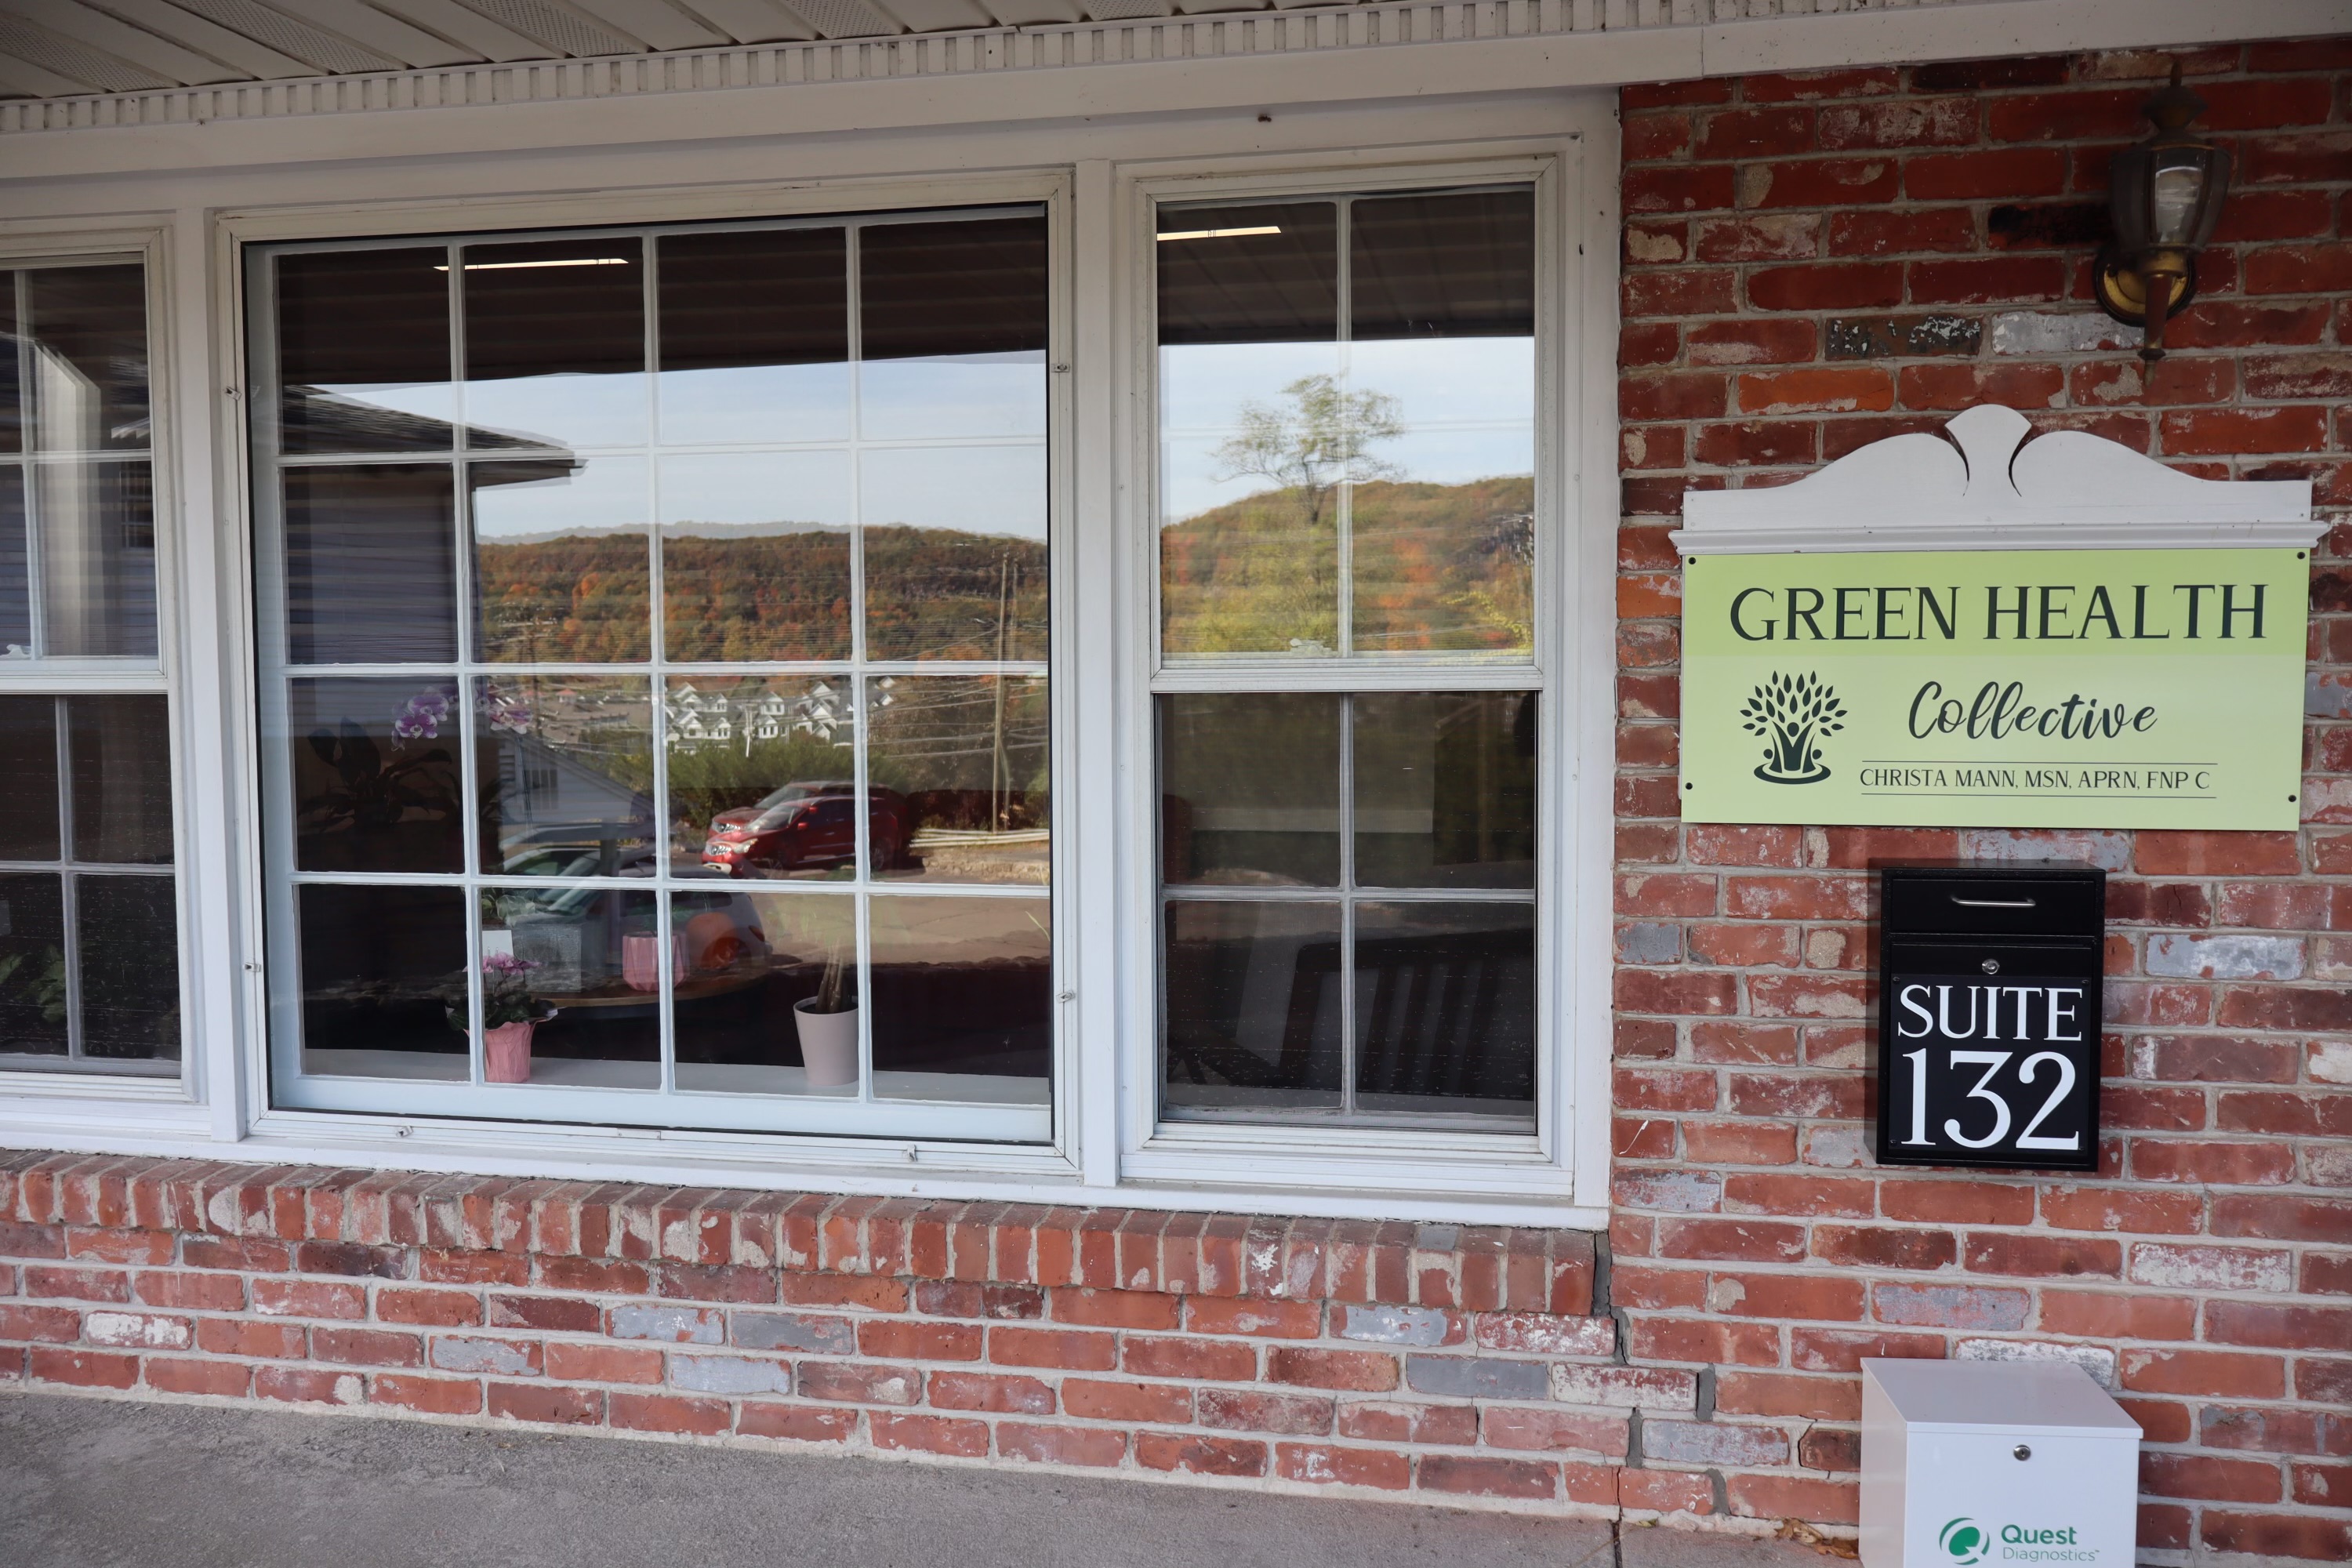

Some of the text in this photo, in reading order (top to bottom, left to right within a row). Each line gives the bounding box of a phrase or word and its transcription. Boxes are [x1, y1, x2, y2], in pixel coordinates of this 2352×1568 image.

[1730, 584, 2269, 641] GREEN HEALTH
[1908, 681, 2158, 739] Collective
[1860, 768, 2209, 790] CHRISTA MANN, MSN, APRN, FNP C
[1898, 984, 2082, 1041] SUITE
[1901, 1047, 2079, 1149] 132
[2001, 1524, 2078, 1544] Quest
[2003, 1547, 2096, 1562] Diagnostics
